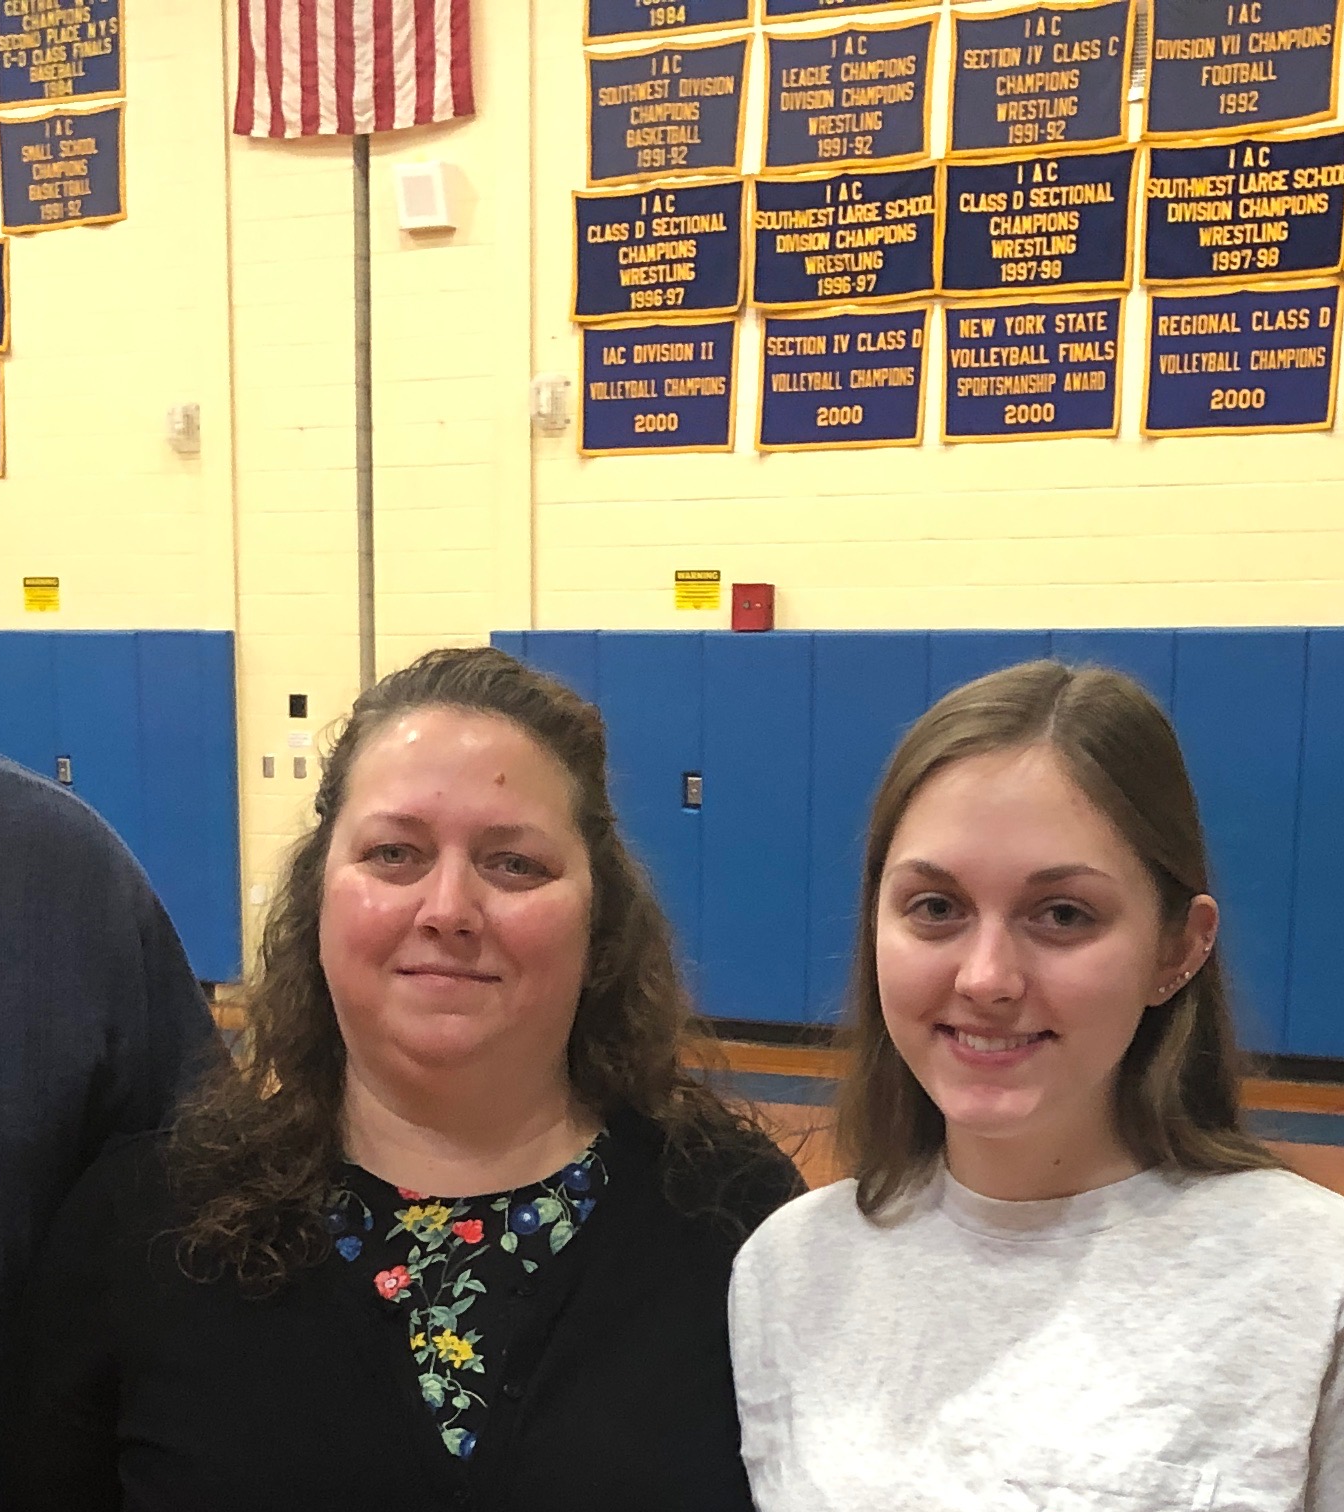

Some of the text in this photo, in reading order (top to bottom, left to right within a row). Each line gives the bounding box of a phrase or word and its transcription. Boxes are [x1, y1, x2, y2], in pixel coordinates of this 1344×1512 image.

[650, 7, 686, 26] 1984
[963, 36, 1119, 69] SECTION IV CLASS C
[1156, 24, 1331, 60] DIVISION VII CHAMPIONS
[782, 56, 916, 87] LEAGUE CHAMPIONS
[996, 70, 1080, 96] CHAMPIONS
[1201, 61, 1277, 87] FOOTBALL
[599, 77, 735, 106] SOUTHWEST DIVISION
[780, 82, 915, 111] DIVISION CHAMPIONS
[1219, 92, 1258, 114] 1992
[630, 102, 699, 125] CHAMPIONS
[997, 96, 1077, 122] WRESTLING
[809, 112, 882, 136] WRESTLING
[1008, 121, 1065, 144] 1991-92
[627, 125, 701, 148] BASKETBALL
[817, 137, 873, 158] 1991-92
[637, 147, 688, 168] 1991-92
[1147, 174, 1235, 198] SOUTHWEST
[1238, 170, 1290, 192] LARGE
[960, 182, 1114, 213] CLASS D SECTIONAL
[1167, 193, 1328, 223] DIVISION CHAMPIONS
[756, 195, 935, 230] SOUTHWEST LARGE SCHOOL
[989, 212, 1080, 236] CHAMPIONS
[587, 214, 727, 243] CLASS D SECTIONAL
[776, 224, 917, 253] DIVISION CHAMPIONS
[1199, 221, 1288, 247] WRESTLING
[618, 241, 696, 264] CHAMPIONS
[991, 235, 1076, 259] WRESTLING
[805, 252, 883, 275] WRESTLING
[1001, 260, 1062, 282] 1997-98
[1212, 248, 1279, 271] 1997-98
[620, 265, 695, 286] WRESTLING
[817, 275, 877, 296] 1996-97
[630, 288, 684, 309] 1996-97
[960, 311, 1108, 338] NEW YORK STATE
[1159, 307, 1330, 336] REGIONAL CLASS D
[603, 342, 714, 365] IAC DIVISION II
[767, 327, 922, 357] SECTION IV CLASS D
[952, 341, 1114, 368] VOLLEYBALL FINALS
[1159, 347, 1326, 374] VOLLEYBALL CHAMPIONS
[590, 377, 726, 400] VOLLEYBALL CHAMPIONS
[771, 367, 915, 392] VOLLEYBALL CHAMPIONS
[957, 371, 1106, 397] SPORTSMANSHIP AWARD
[1210, 389, 1265, 410] 2000
[634, 413, 678, 433] 2000
[817, 406, 863, 426] 2000
[1004, 403, 1055, 424] 2000
